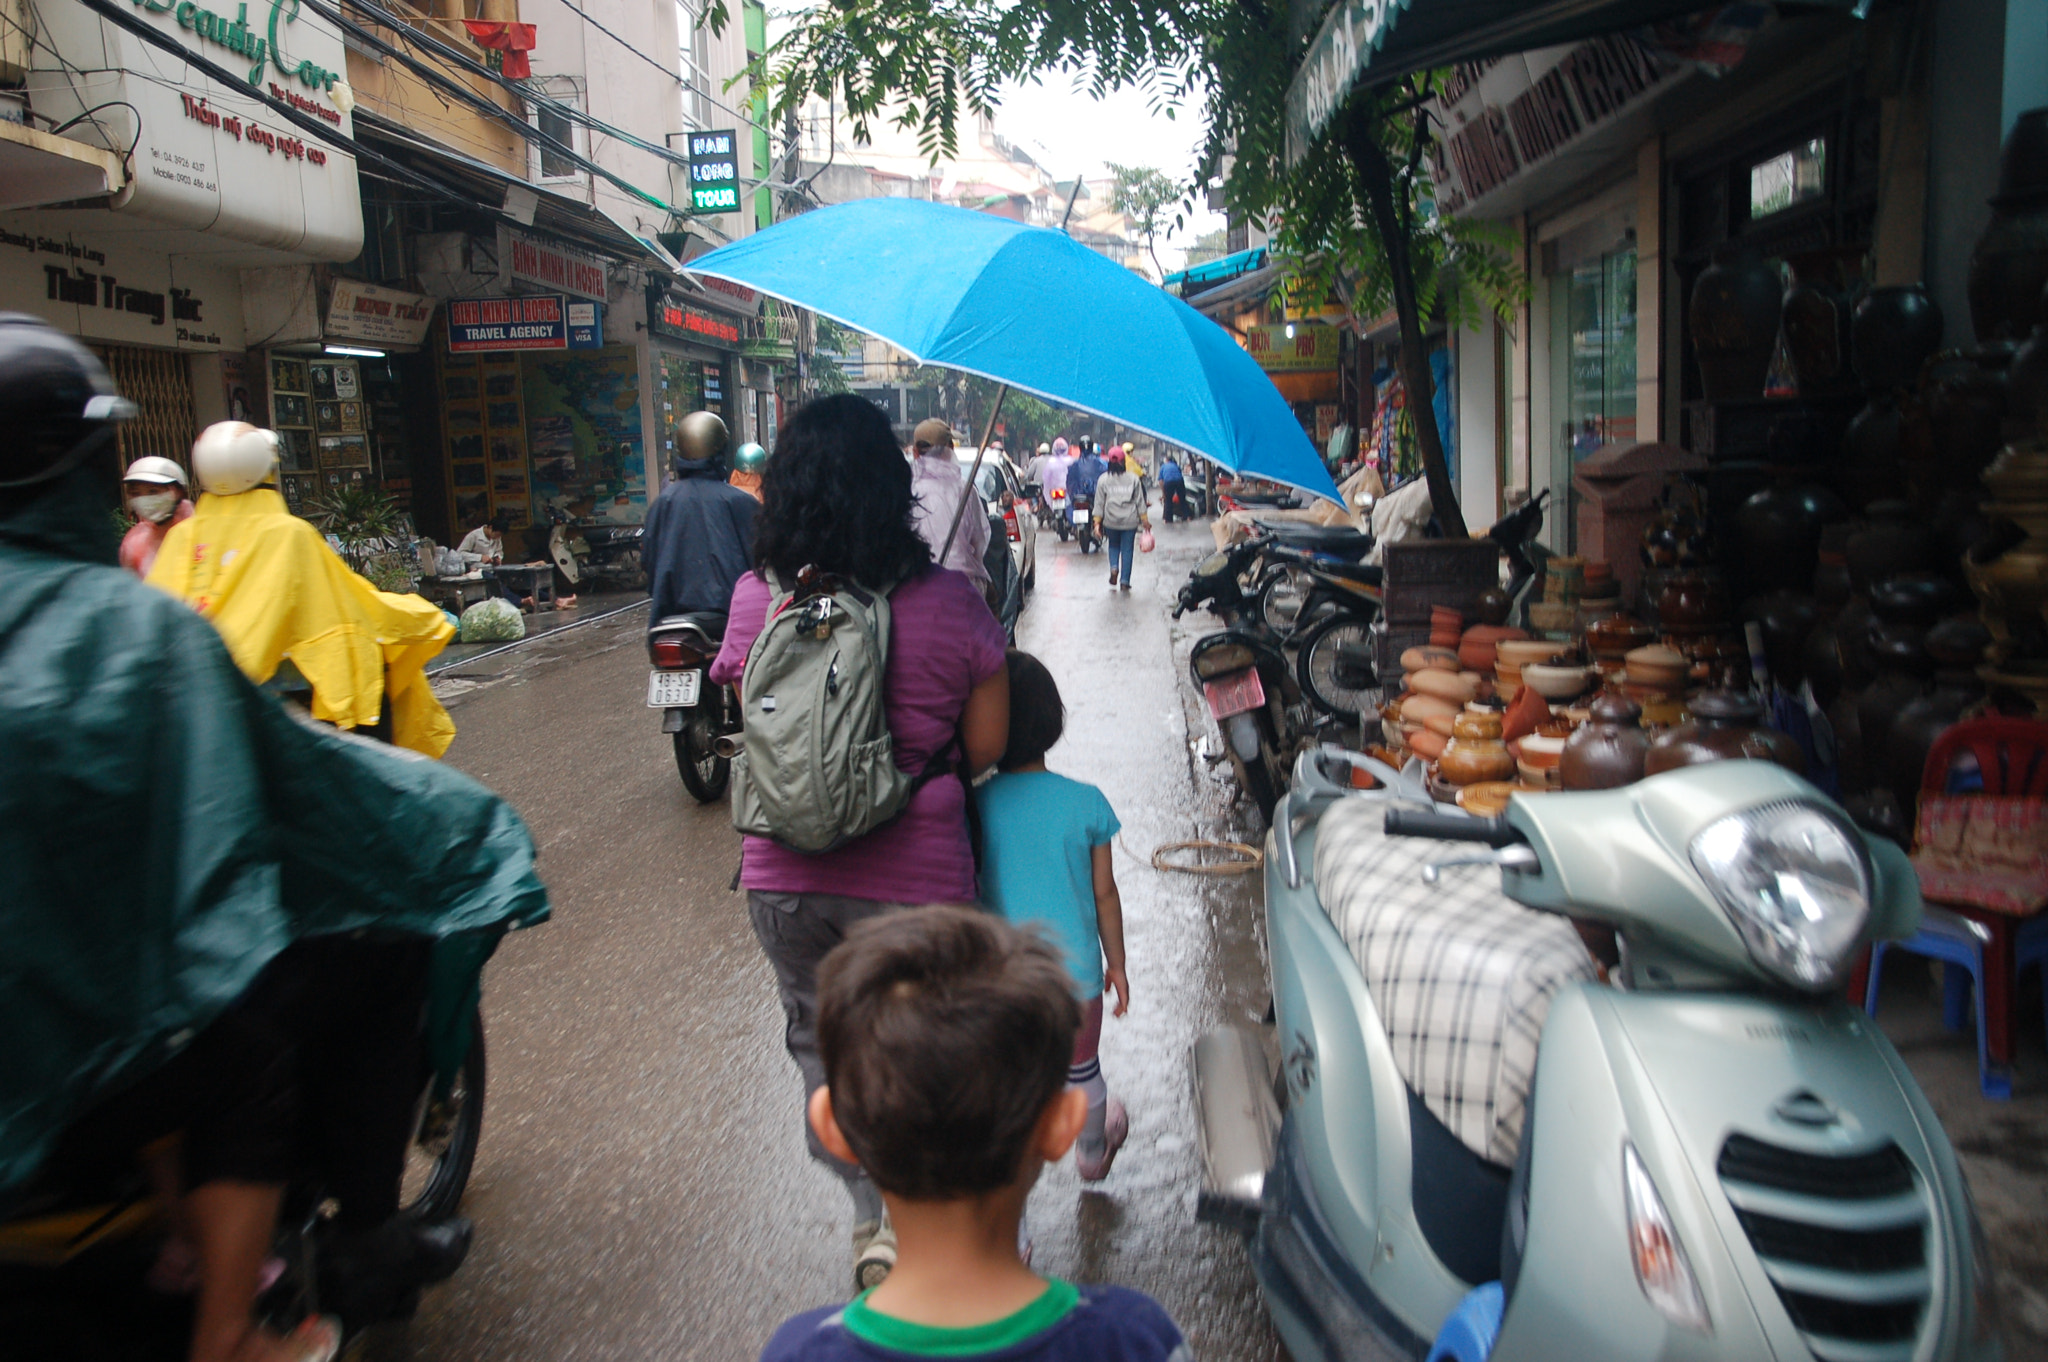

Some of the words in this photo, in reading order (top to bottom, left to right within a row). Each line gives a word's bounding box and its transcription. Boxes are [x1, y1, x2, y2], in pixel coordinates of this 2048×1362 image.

[133, 0, 266, 87] eauty
[1506, 66, 1582, 165] MINH
[307, 147, 326, 165] cao
[692, 162, 734, 181] LONG
[694, 189, 736, 208] TOUR
[37, 236, 64, 256] Salon
[83, 245, 105, 266] Long
[540, 250, 565, 286] MINH
[567, 259, 574, 289] II
[575, 262, 605, 298] HOSTEL
[101, 275, 165, 326] Trang
[480, 299, 511, 325] MINH
[511, 298, 522, 323] II
[523, 297, 561, 323] HOTEL
[465, 327, 506, 341] TRAVEL
[510, 325, 553, 338] AGENCY
[575, 334, 592, 342] VISA
[656, 688, 690, 703] 0630
